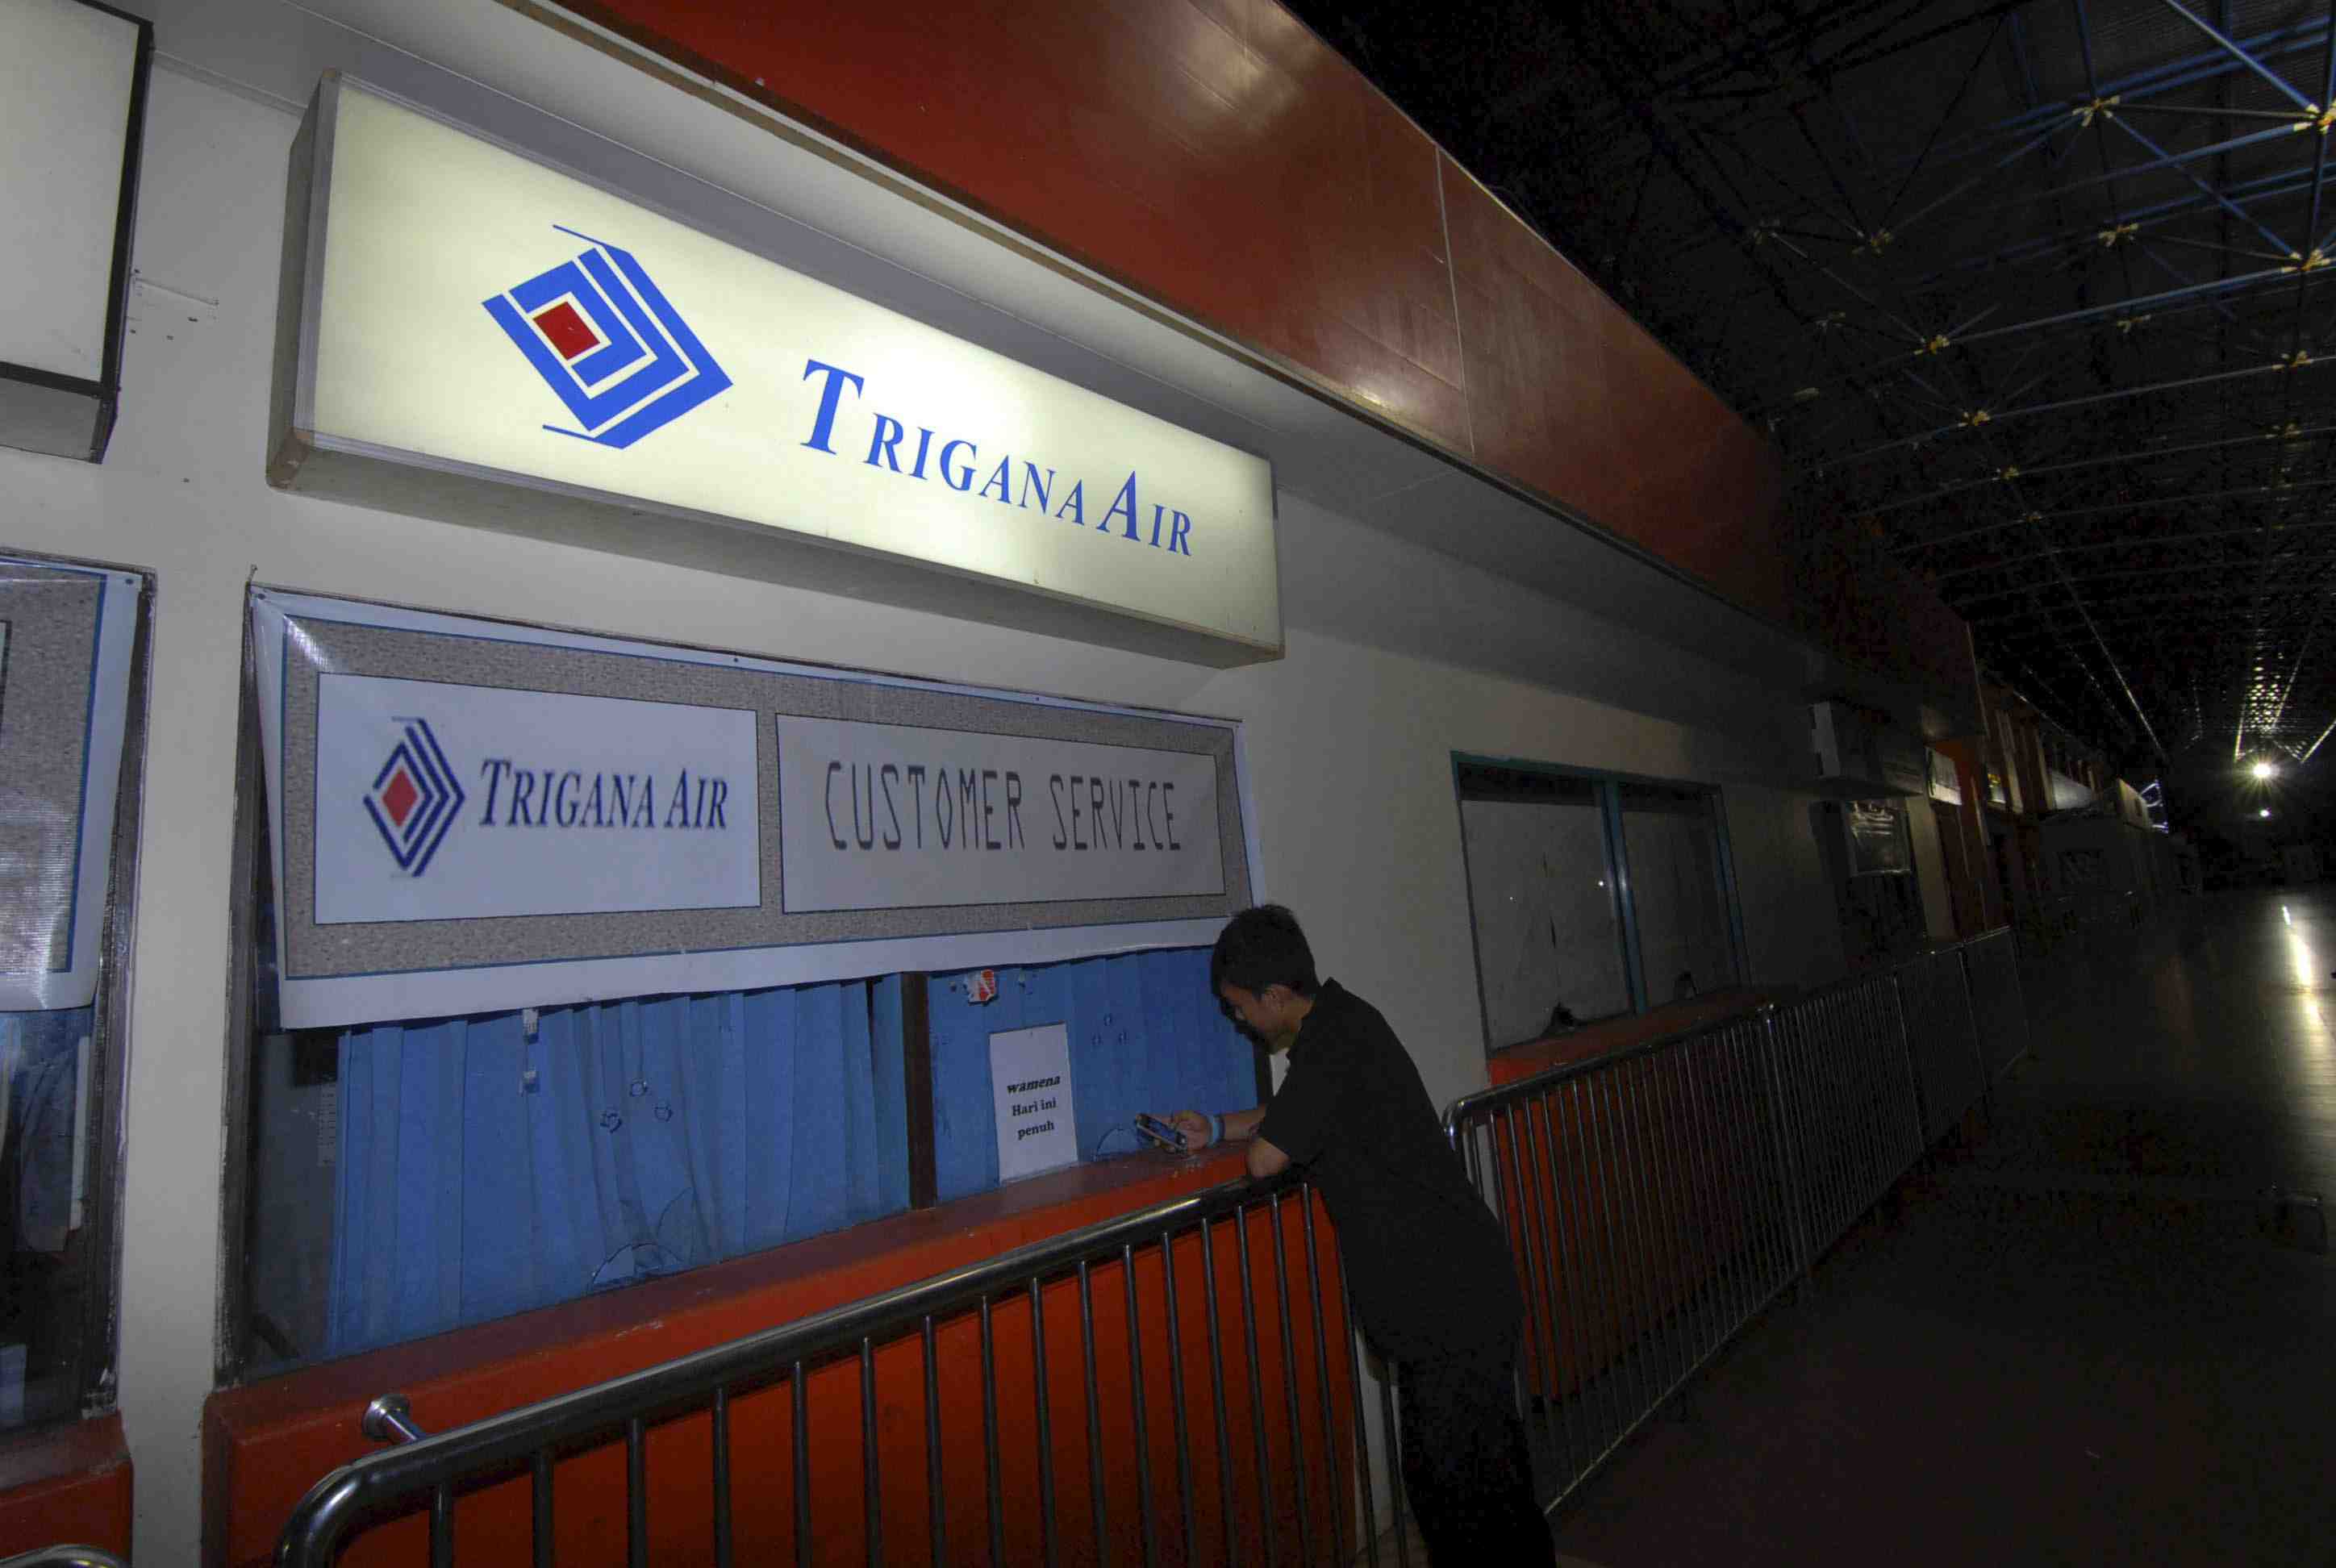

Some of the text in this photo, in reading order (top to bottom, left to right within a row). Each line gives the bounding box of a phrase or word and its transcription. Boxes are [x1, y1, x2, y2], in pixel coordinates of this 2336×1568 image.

[800, 359, 1192, 557] TRIGANA AIR
[478, 758, 728, 829] TRIGANA AIR
[825, 761, 1181, 851] CUSTOMER SERVICE
[1006, 1075, 1061, 1094] wamena
[1012, 1097, 1057, 1116] Hari ini
[1017, 1120, 1054, 1141] penuh
